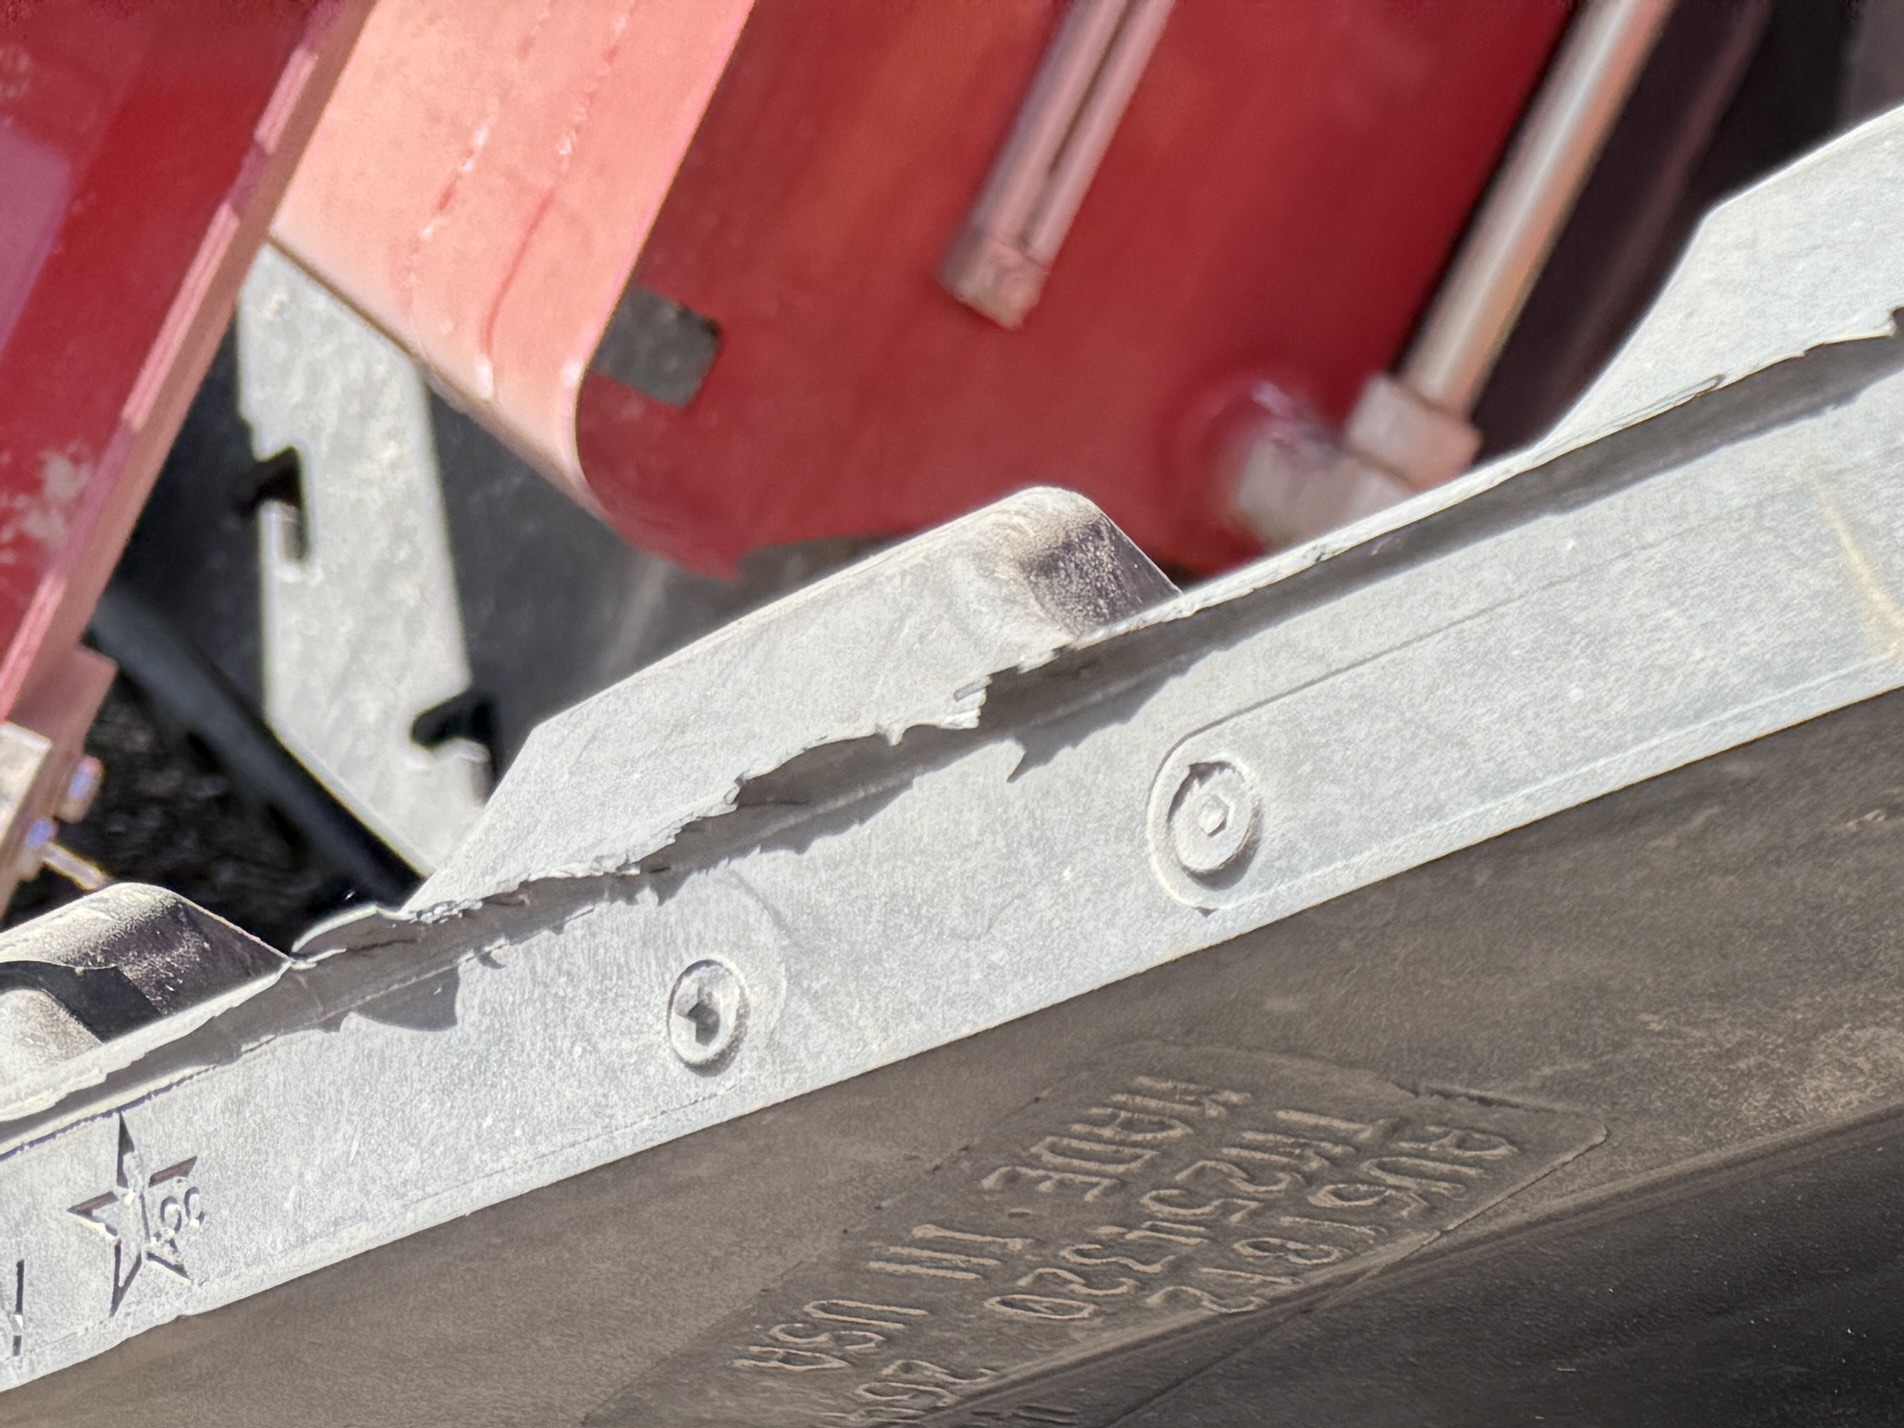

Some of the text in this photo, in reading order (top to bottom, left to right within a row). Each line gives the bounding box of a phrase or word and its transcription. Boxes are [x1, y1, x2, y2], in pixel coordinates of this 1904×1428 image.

[978, 1075, 1252, 1203] MADE
[862, 1225, 1032, 1281] IN
[977, 1103, 1394, 1321] TM254320
[1141, 1124, 1531, 1318] AU61812
[723, 1297, 930, 1376] USA
